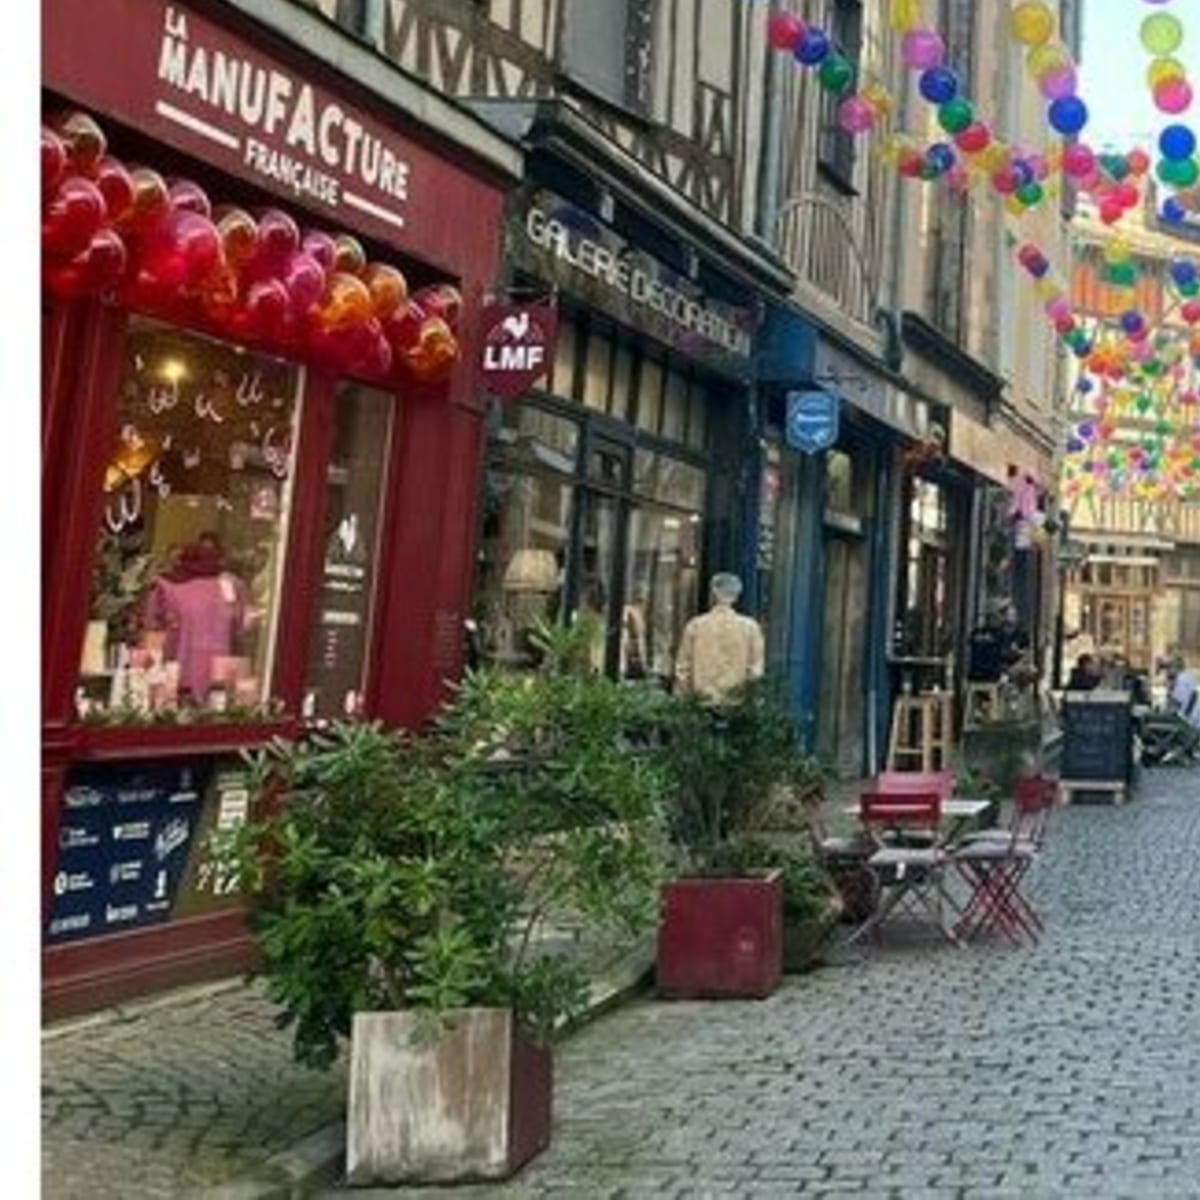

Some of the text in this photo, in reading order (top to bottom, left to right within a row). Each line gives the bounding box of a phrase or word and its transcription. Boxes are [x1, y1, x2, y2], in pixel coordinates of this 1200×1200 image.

[164, 6, 188, 40] LA
[158, 35, 410, 200] MANUFACTURE
[244, 137, 341, 206] FRANÇAISE
[527, 207, 630, 295] GALERIE
[483, 345, 545, 371] LMF
